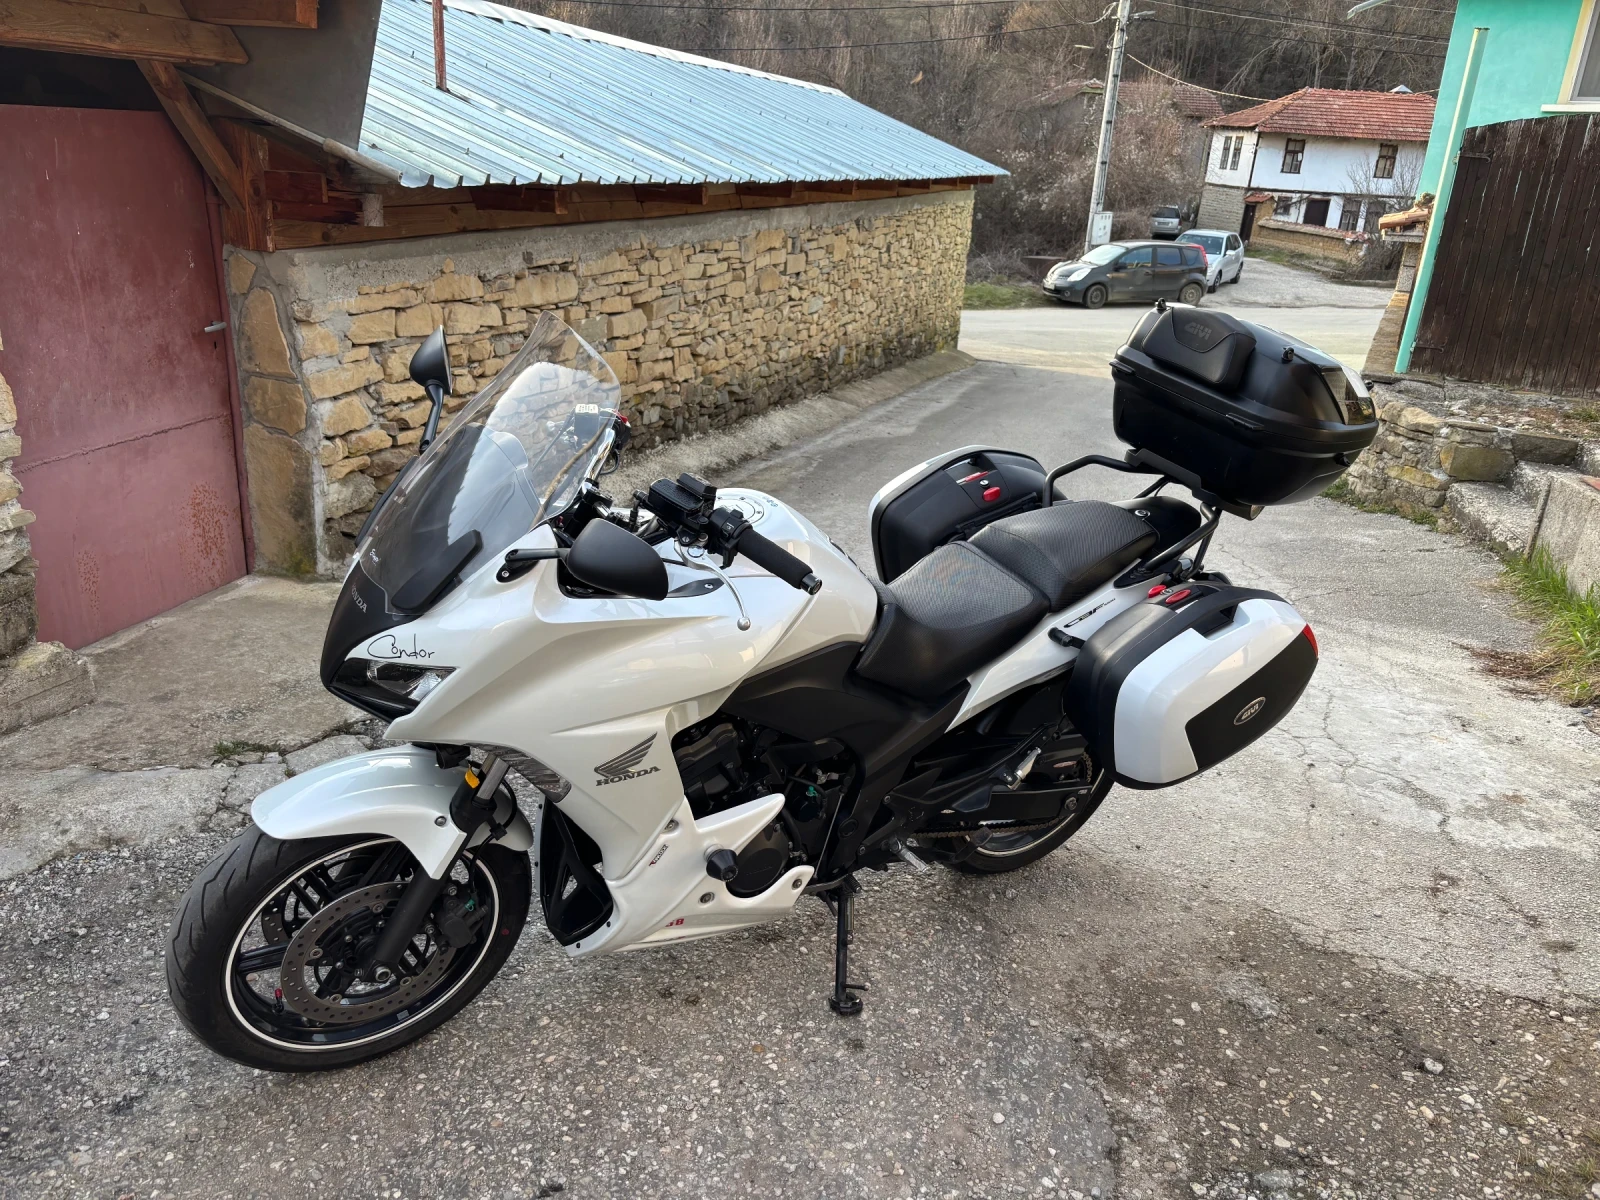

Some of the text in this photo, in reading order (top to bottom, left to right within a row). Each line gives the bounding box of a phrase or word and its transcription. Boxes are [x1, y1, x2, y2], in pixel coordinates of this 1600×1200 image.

[1184, 322, 1213, 340] GIVI
[366, 633, 435, 659] Condor
[1241, 703, 1259, 720] GIVI
[596, 766, 661, 787] HONDA
